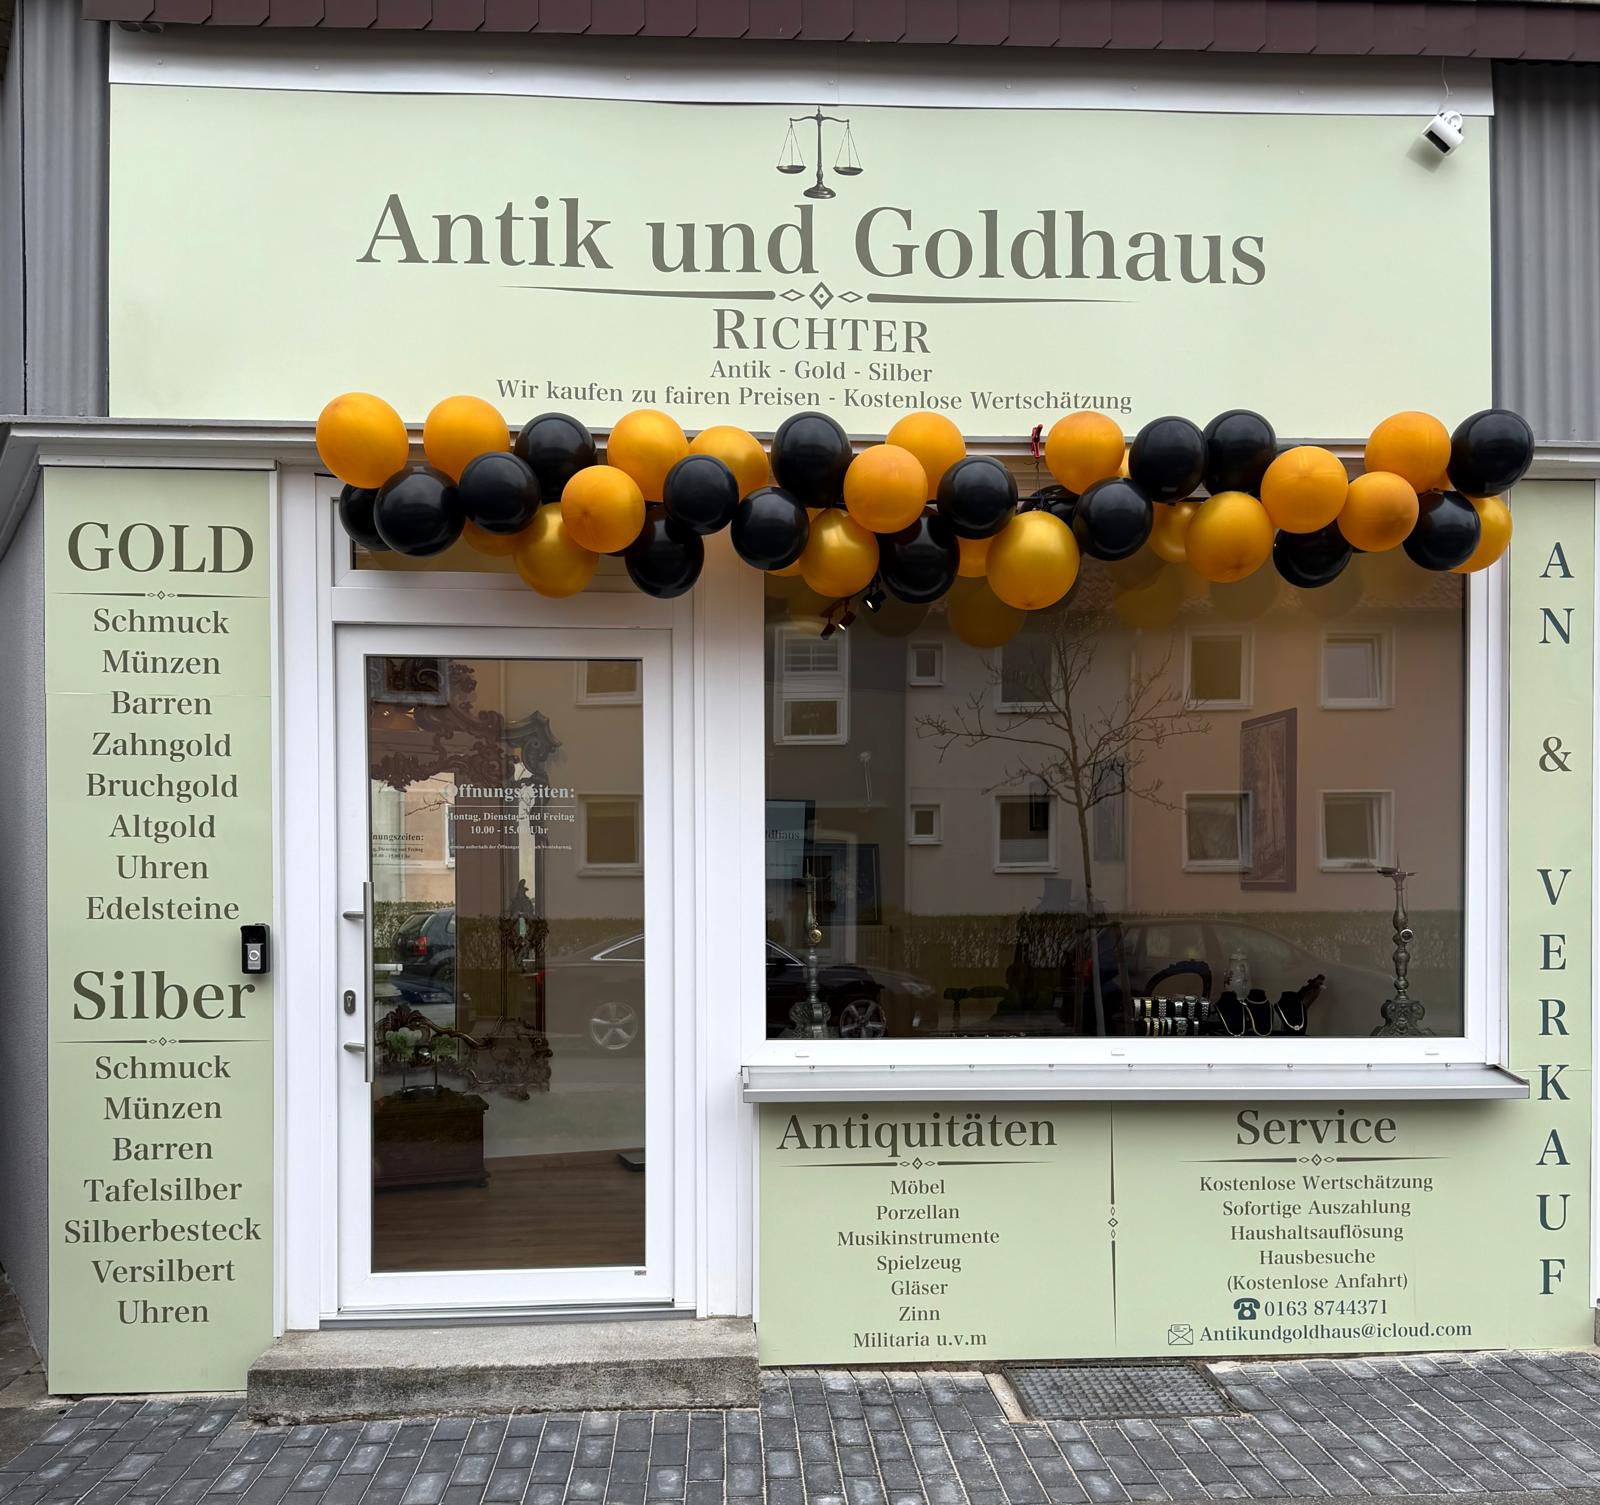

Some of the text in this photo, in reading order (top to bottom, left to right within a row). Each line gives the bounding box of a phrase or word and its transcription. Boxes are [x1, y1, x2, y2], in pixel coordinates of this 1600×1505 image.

[356, 193, 1267, 287] Antik und Goldhaus
[713, 307, 932, 355] RICHTER
[710, 360, 771, 378] Antik
[795, 360, 846, 379] Gold
[869, 363, 932, 382] Silber
[496, 379, 539, 399] Wir
[546, 381, 624, 403] kaufen
[632, 387, 656, 404] zu
[665, 385, 730, 406] fairen
[738, 386, 821, 407] Preisen
[843, 388, 963, 410] Kostenlose
[970, 390, 1133, 414] Wertschätzung
[68, 522, 253, 573] GOLD
[94, 608, 229, 634] Schmuck
[102, 650, 221, 674] Münzen
[111, 691, 212, 715] Barren
[92, 732, 231, 762] Zahngold
[87, 773, 238, 803] Bruchgold
[442, 784, 575, 802] ffnungseiten:
[109, 814, 215, 844] Altgold
[523, 812, 541, 821] nd
[543, 812, 575, 823] Freitag
[372, 832, 424, 843] nungszeiten:
[470, 826, 495, 835] 10.00
[504, 826, 529, 835] 15.0
[116, 855, 208, 879] Uhren
[86, 896, 239, 920] Edelsteine
[1536, 542, 1575, 1296] AN & VERKAUF
[72, 969, 256, 1021] Silber
[96, 1055, 231, 1079] Schmuck
[104, 1097, 222, 1120] Münzen
[776, 1111, 1058, 1158] Antiquitäten
[1236, 1108, 1397, 1146] Service
[113, 1138, 213, 1161] Barren
[84, 1177, 242, 1202] Tafelsilber
[891, 1179, 945, 1195] Möbel
[1200, 1175, 1433, 1192] Kostenlose Wertschätzung
[877, 1204, 960, 1220] Porzellan
[1223, 1199, 1411, 1219] Sofortige Auszahlung
[65, 1217, 262, 1243] Silberbesteck
[838, 1230, 999, 1246] Musikinstrumente
[1231, 1223, 1404, 1242] Haushaltsauflösung
[877, 1255, 961, 1274] Spielzeug
[1260, 1249, 1375, 1264] Hausbesuche
[91, 1259, 235, 1283] Versilbert
[891, 1280, 948, 1295] Gläser
[1227, 1273, 1407, 1293] (Kostenlose Anfahrt)
[118, 1300, 208, 1324] Uhren
[899, 1306, 940, 1321] Zinn
[1264, 1299, 1387, 1316] 0163 8744371
[854, 1331, 986, 1348] Militaria u.v.m
[1200, 1322, 1472, 1344] Antikundgoldhaus@icloud.com
